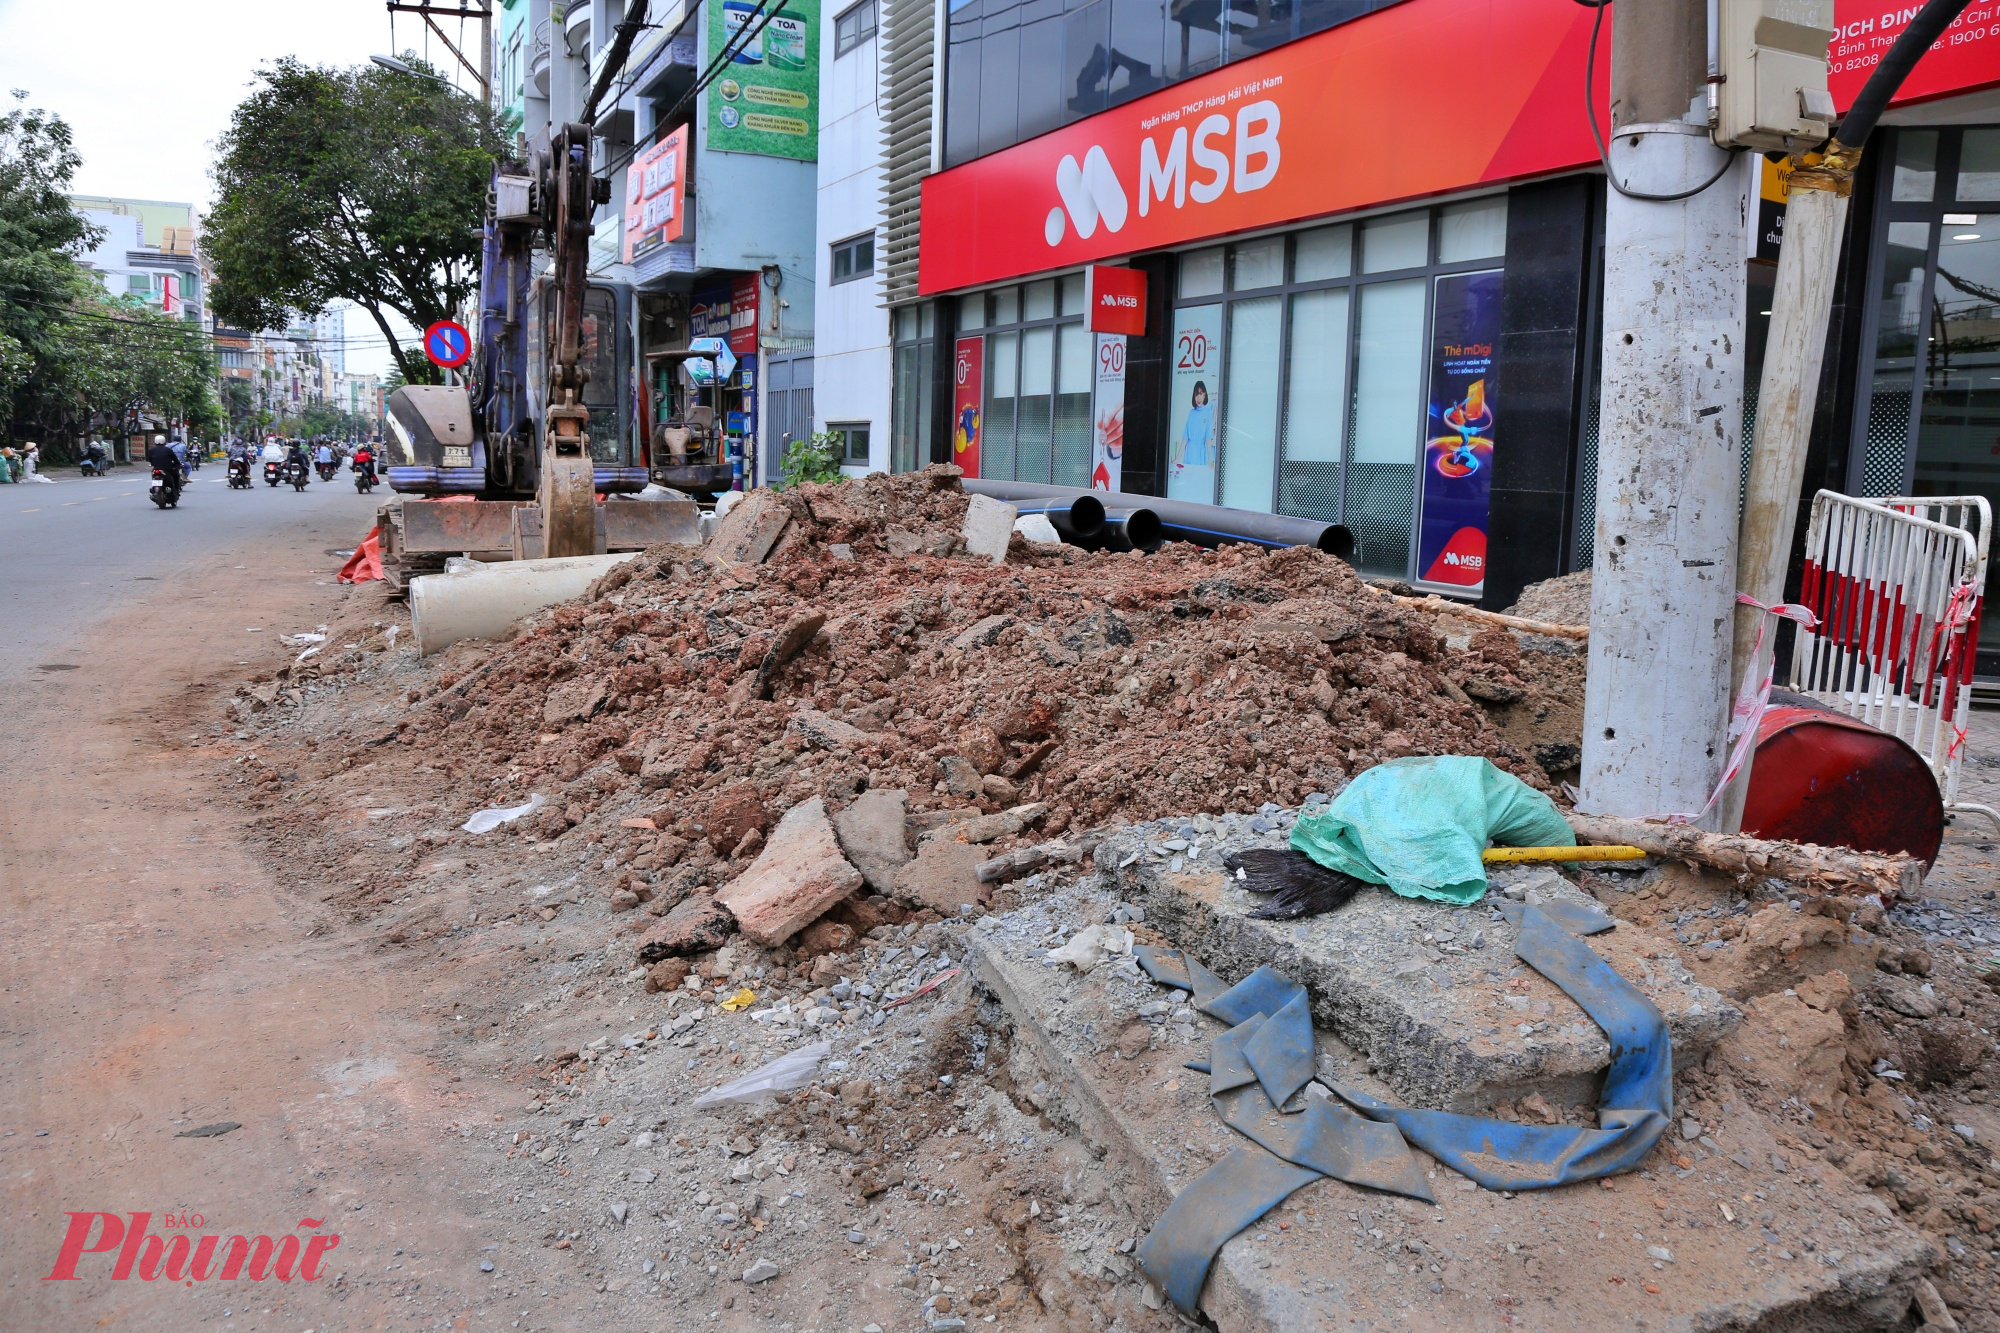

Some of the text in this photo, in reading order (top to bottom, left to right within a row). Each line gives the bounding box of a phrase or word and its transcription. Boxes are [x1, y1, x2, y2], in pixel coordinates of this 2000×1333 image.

[777, 20, 796, 30] TOA
[1870, 31, 1904, 49] Thạn
[1967, 7, 1992, 24] Chí
[1880, 5, 1924, 29] ĐIN
[1846, 54, 1879, 71] 8208
[1949, 27, 1985, 46] 1900
[1141, 75, 1283, 130] Ngân Hàng TMCP Hàng Hải Việt Nam
[1138, 100, 1281, 218] MSB
[1117, 296, 1138, 308] MSB
[692, 315, 705, 334] TOA
[1100, 342, 1123, 373] 90
[1178, 334, 1207, 368] 20
[1444, 343, 1492, 357] Thẻ mDigi
[1460, 554, 1483, 567] MSB
